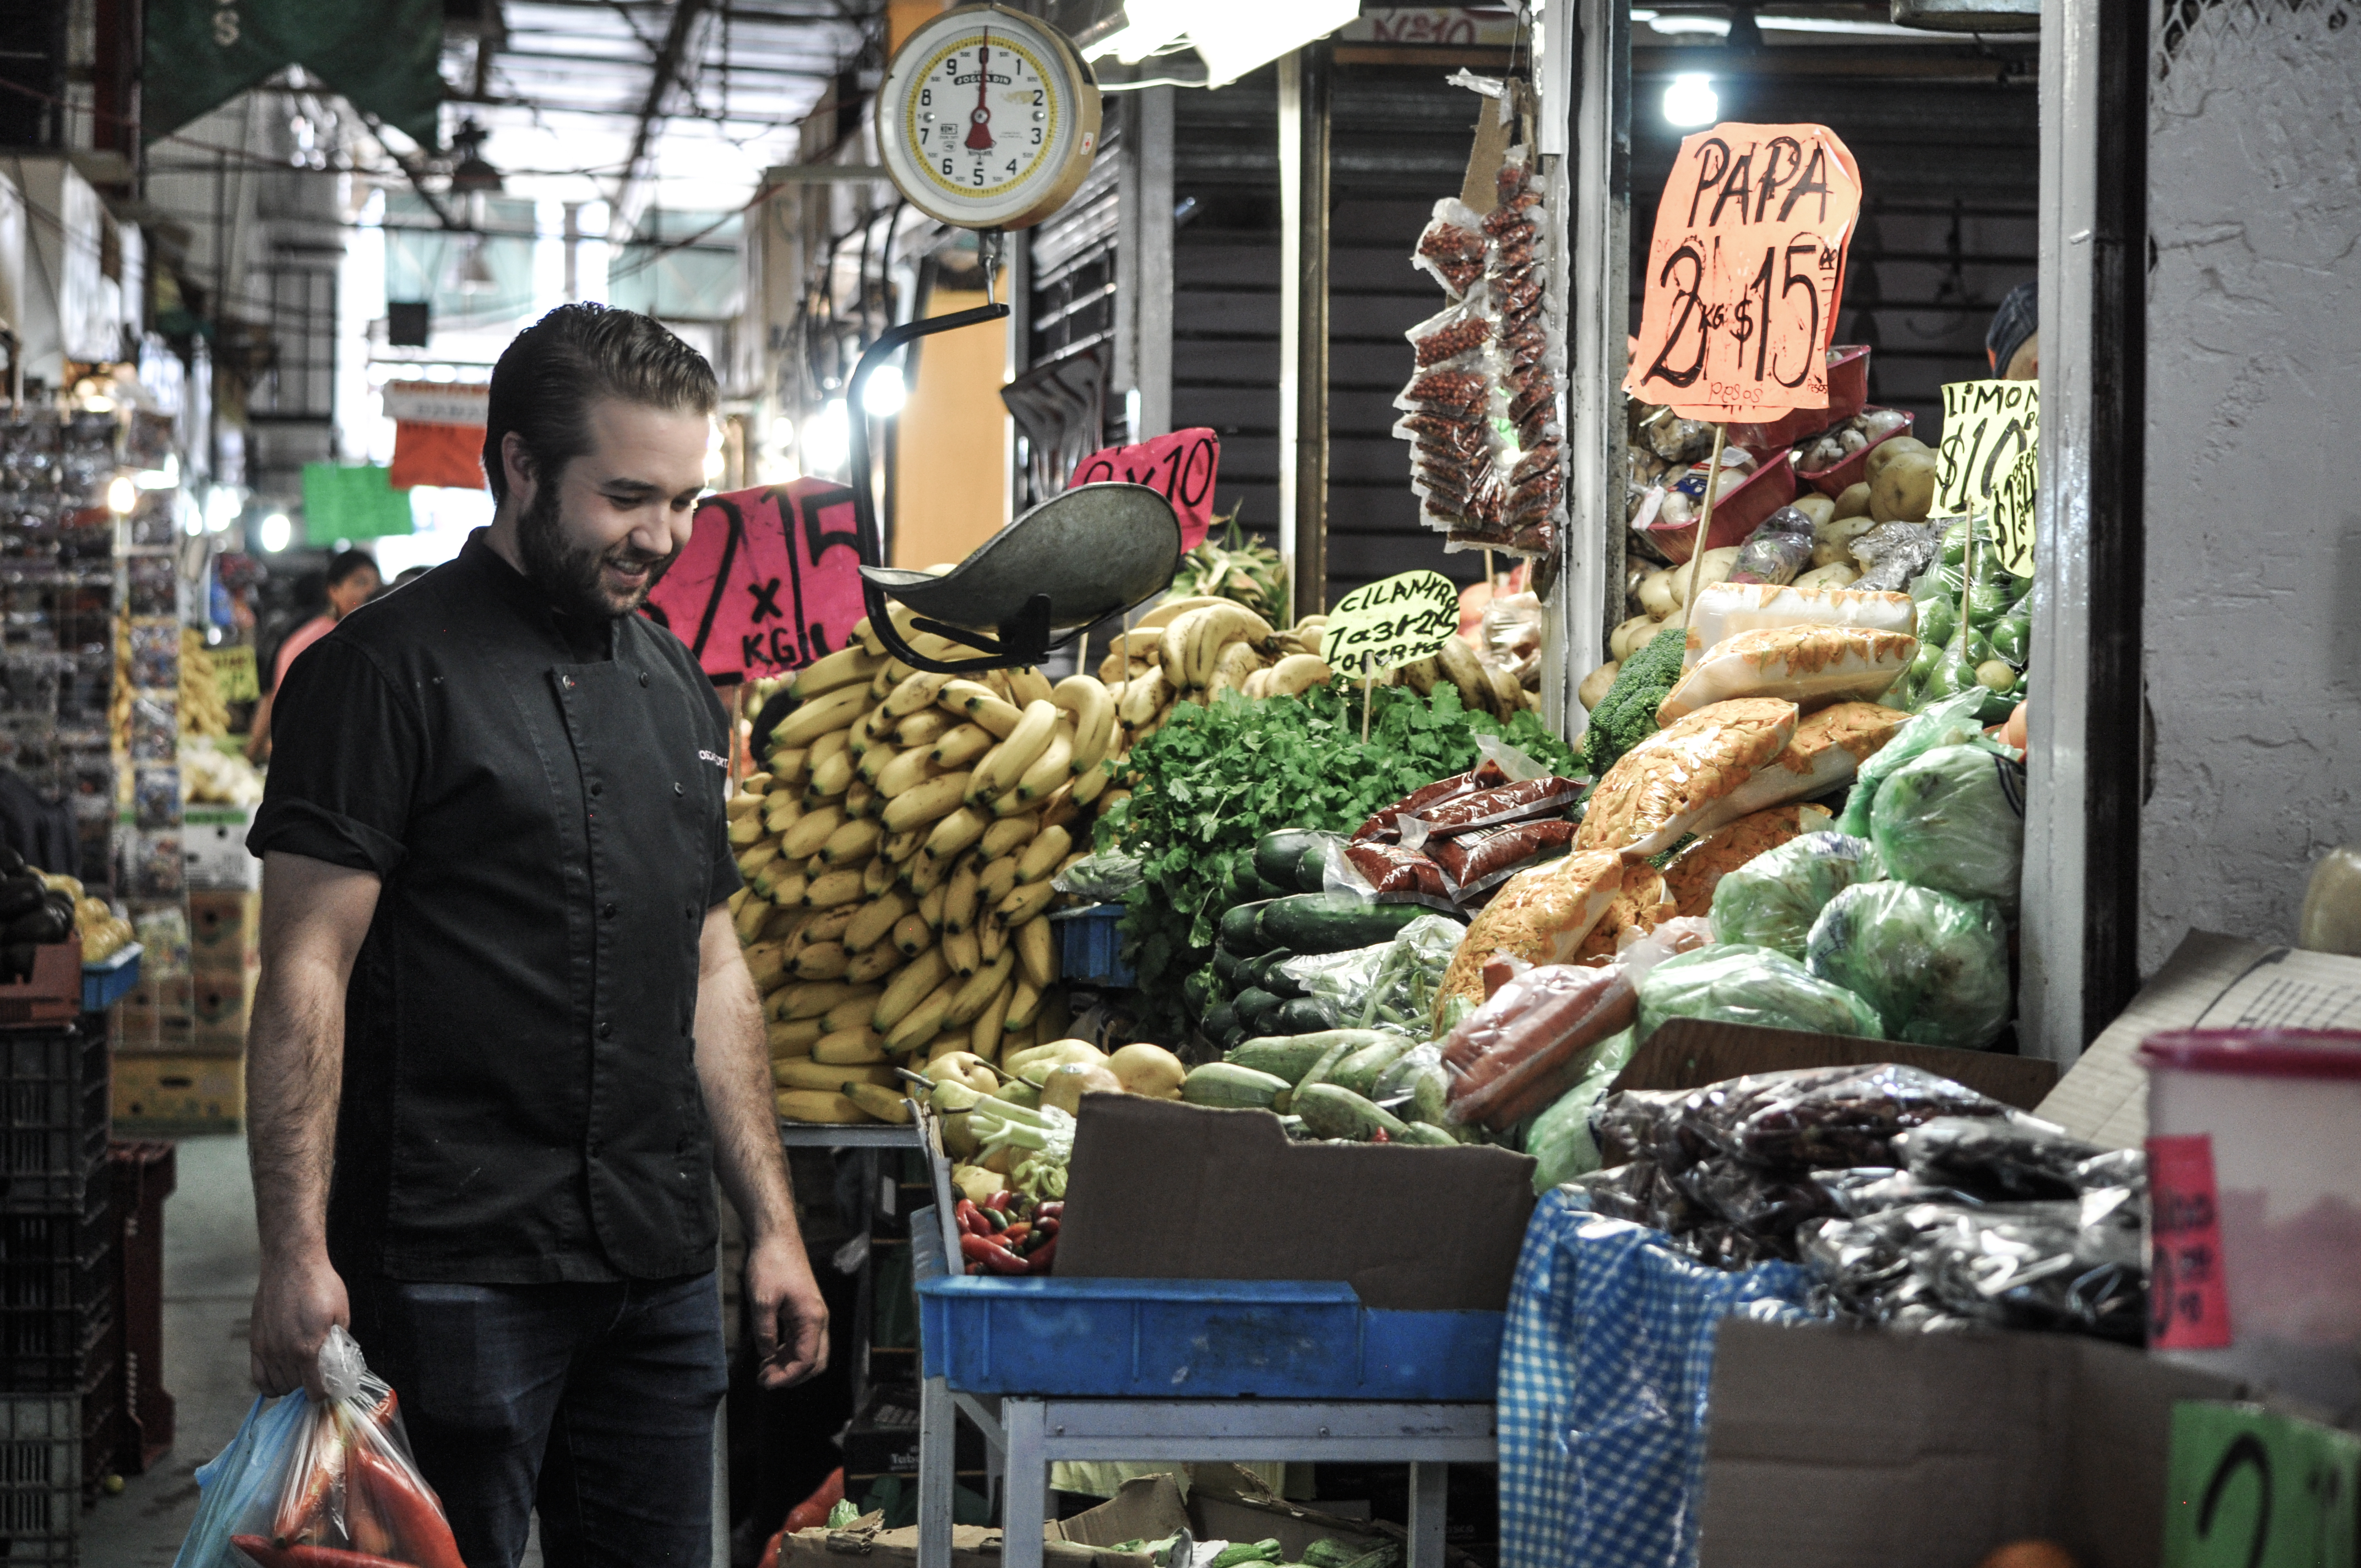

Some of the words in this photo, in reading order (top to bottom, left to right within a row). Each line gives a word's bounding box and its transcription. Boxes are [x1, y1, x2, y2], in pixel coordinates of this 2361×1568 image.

[946, 58, 957, 75] 9
[1016, 58, 1021, 75] 1
[921, 89, 931, 106] 8
[1032, 89, 1043, 106] 2
[920, 128, 929, 145] 7
[1031, 127, 1041, 145] 3
[942, 158, 953, 175] 6
[1005, 159, 1016, 176] 4
[973, 168, 984, 186] 5
[1687, 136, 1834, 228] PAPA
[742, 627, 796, 669] KG
